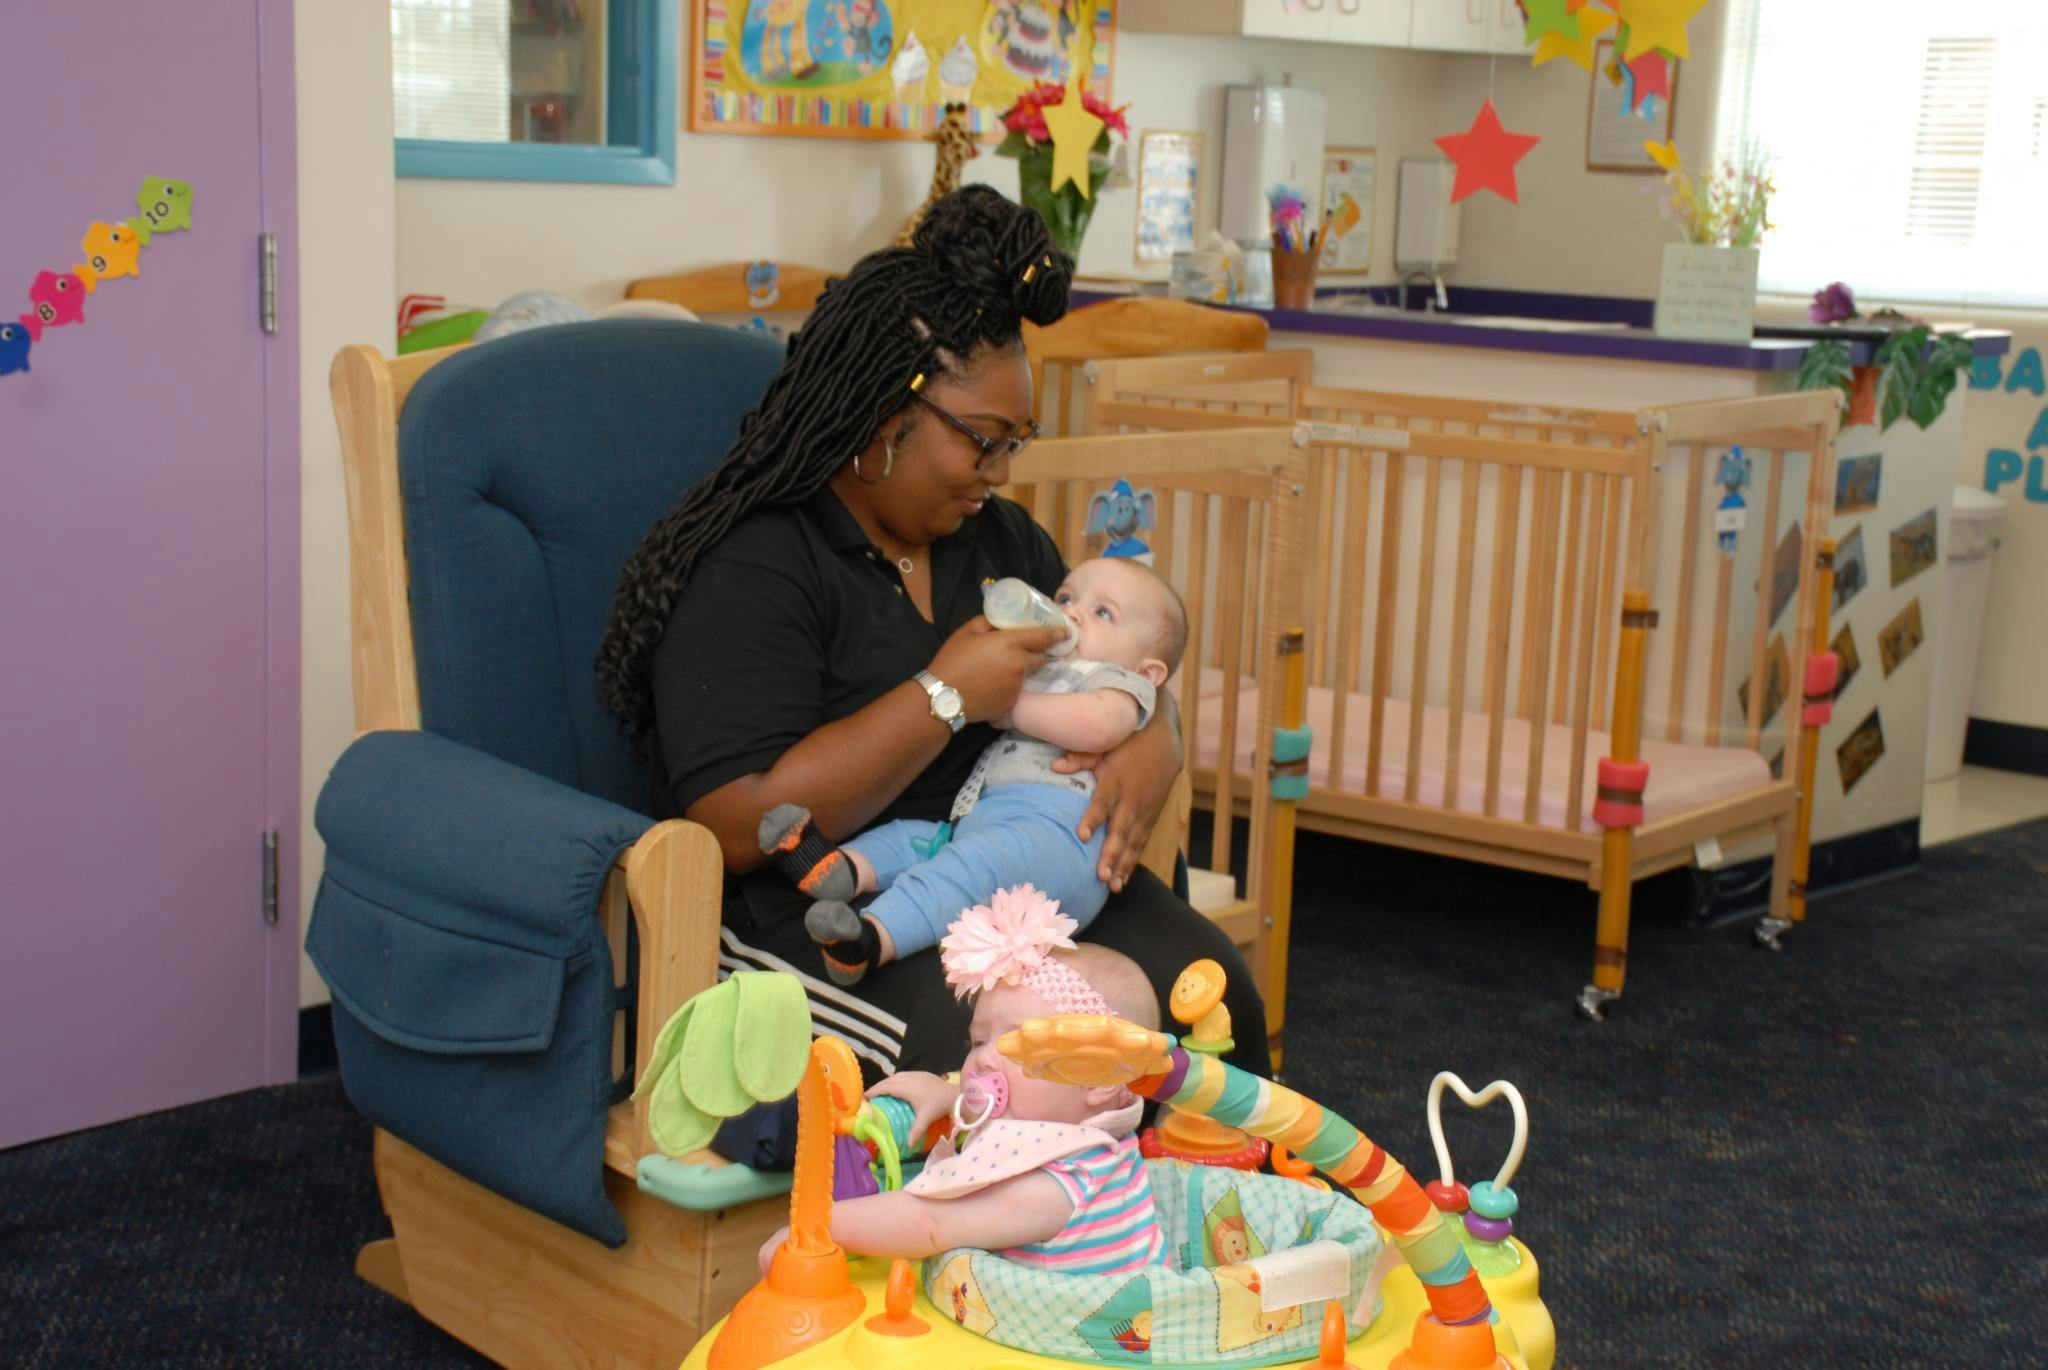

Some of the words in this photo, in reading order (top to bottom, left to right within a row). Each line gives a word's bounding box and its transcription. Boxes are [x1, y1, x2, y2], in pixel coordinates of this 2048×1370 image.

[145, 201, 169, 226] 10
[92, 255, 107, 272] 9
[38, 302, 55, 322] 8
